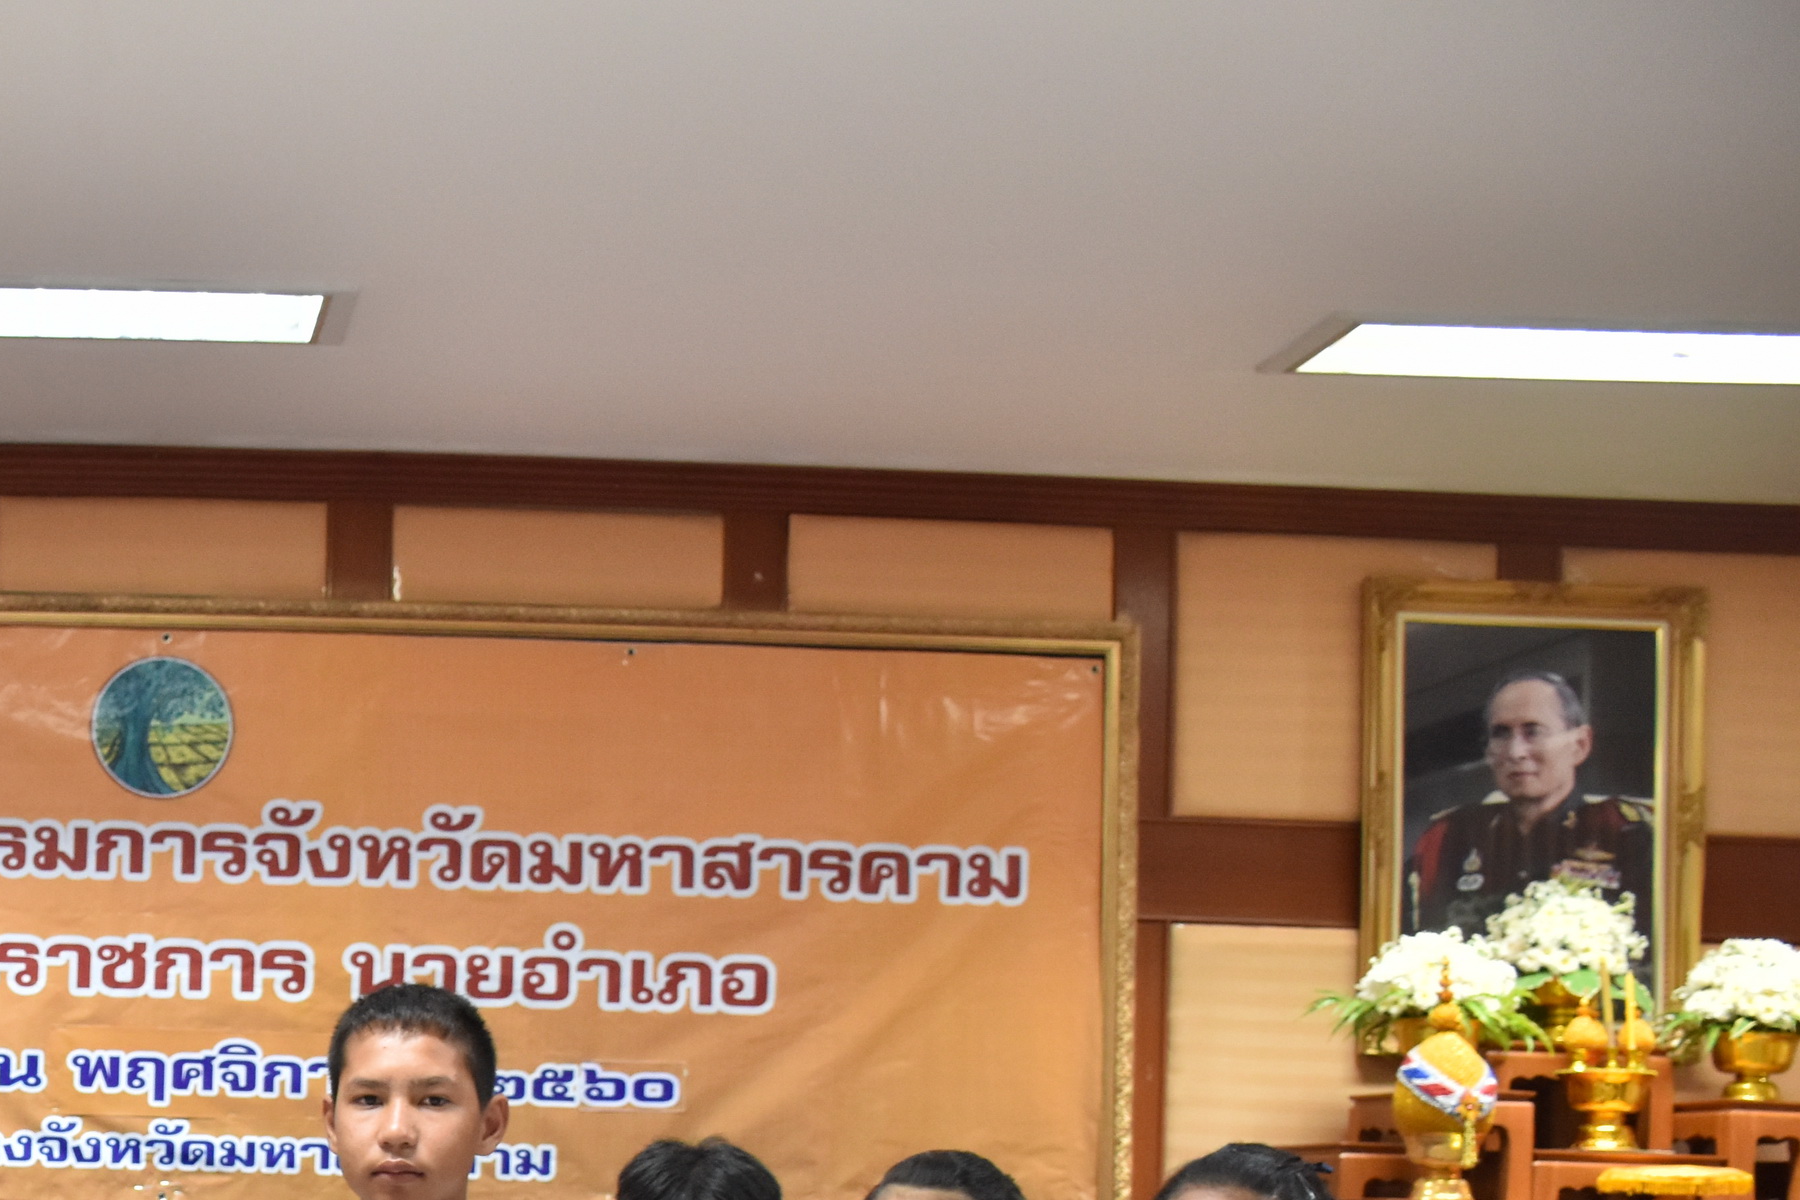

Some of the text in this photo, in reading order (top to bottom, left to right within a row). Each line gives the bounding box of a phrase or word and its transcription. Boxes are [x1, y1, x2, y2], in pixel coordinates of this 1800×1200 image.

[349, 922, 775, 1012] นายอำเภอ
[70, 1042, 330, 1105] พฤศจิก
